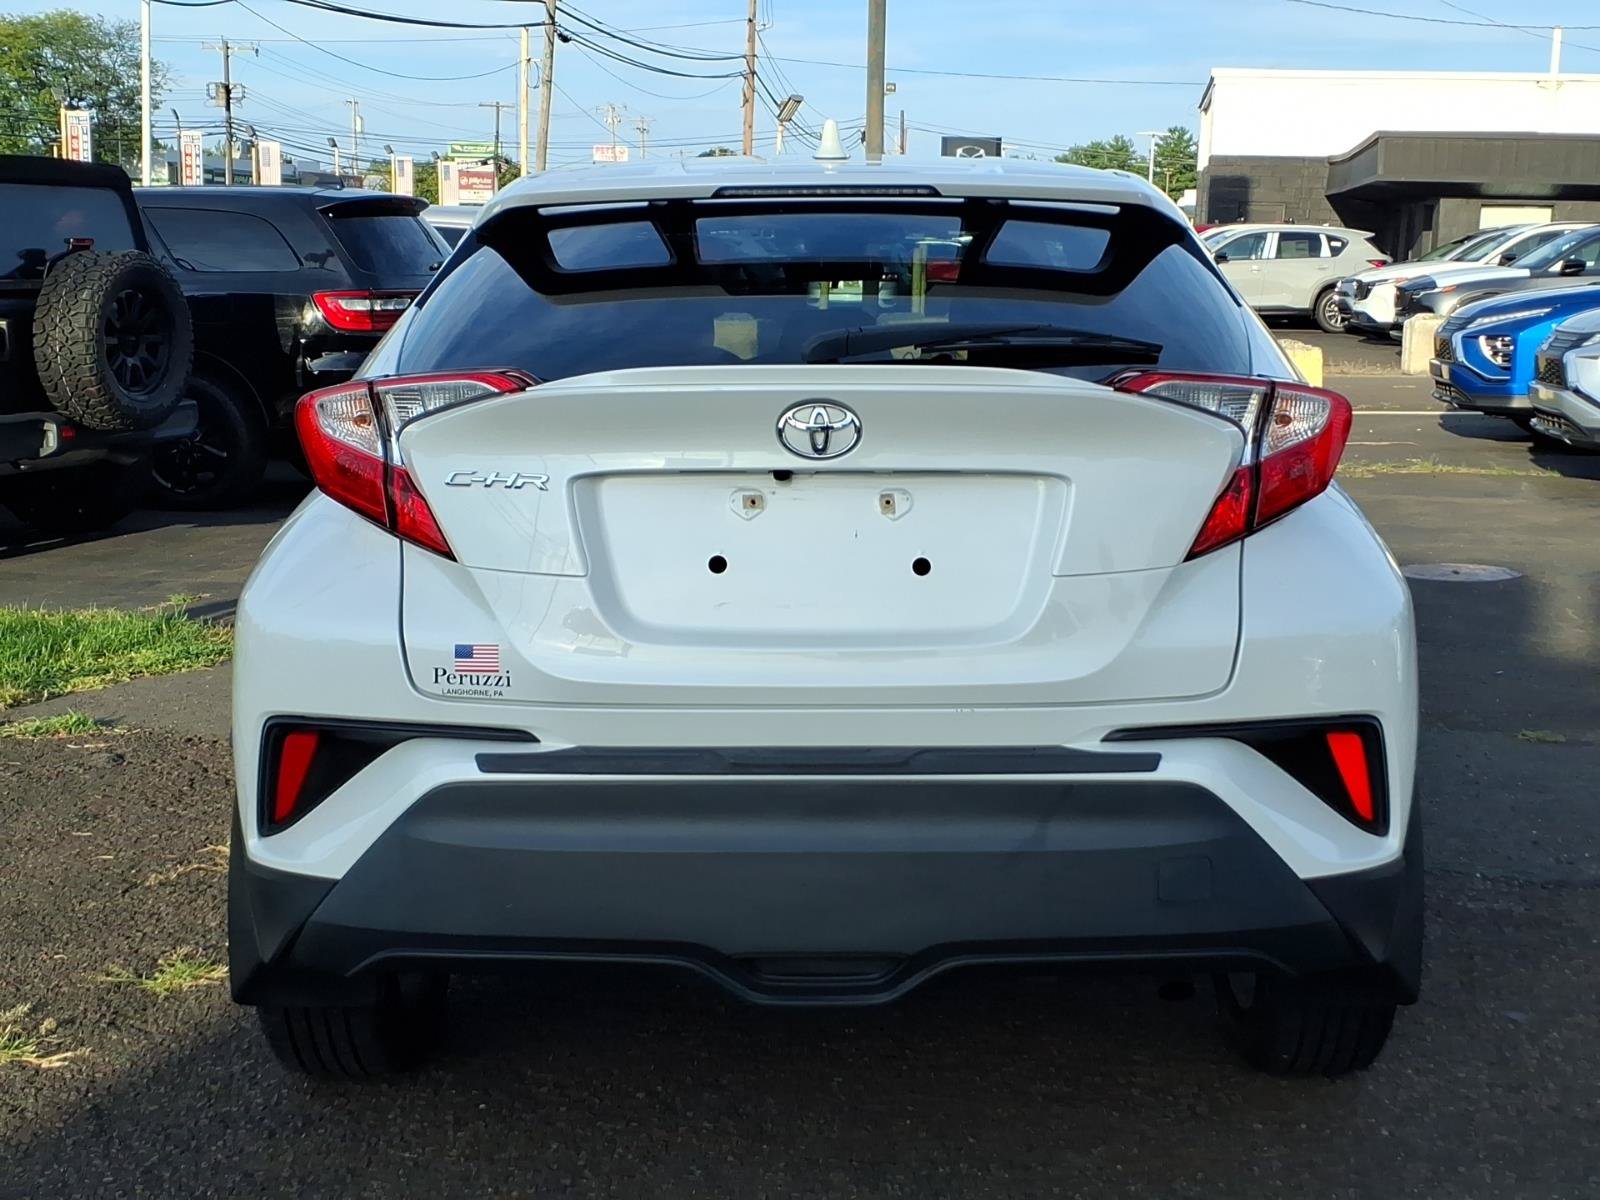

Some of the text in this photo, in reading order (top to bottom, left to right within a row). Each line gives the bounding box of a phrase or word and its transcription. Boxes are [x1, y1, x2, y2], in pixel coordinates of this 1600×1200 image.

[444, 470, 549, 491] C-HR
[433, 667, 511, 687] Peruzzi
[441, 688, 492, 697] LANGHORNE,
